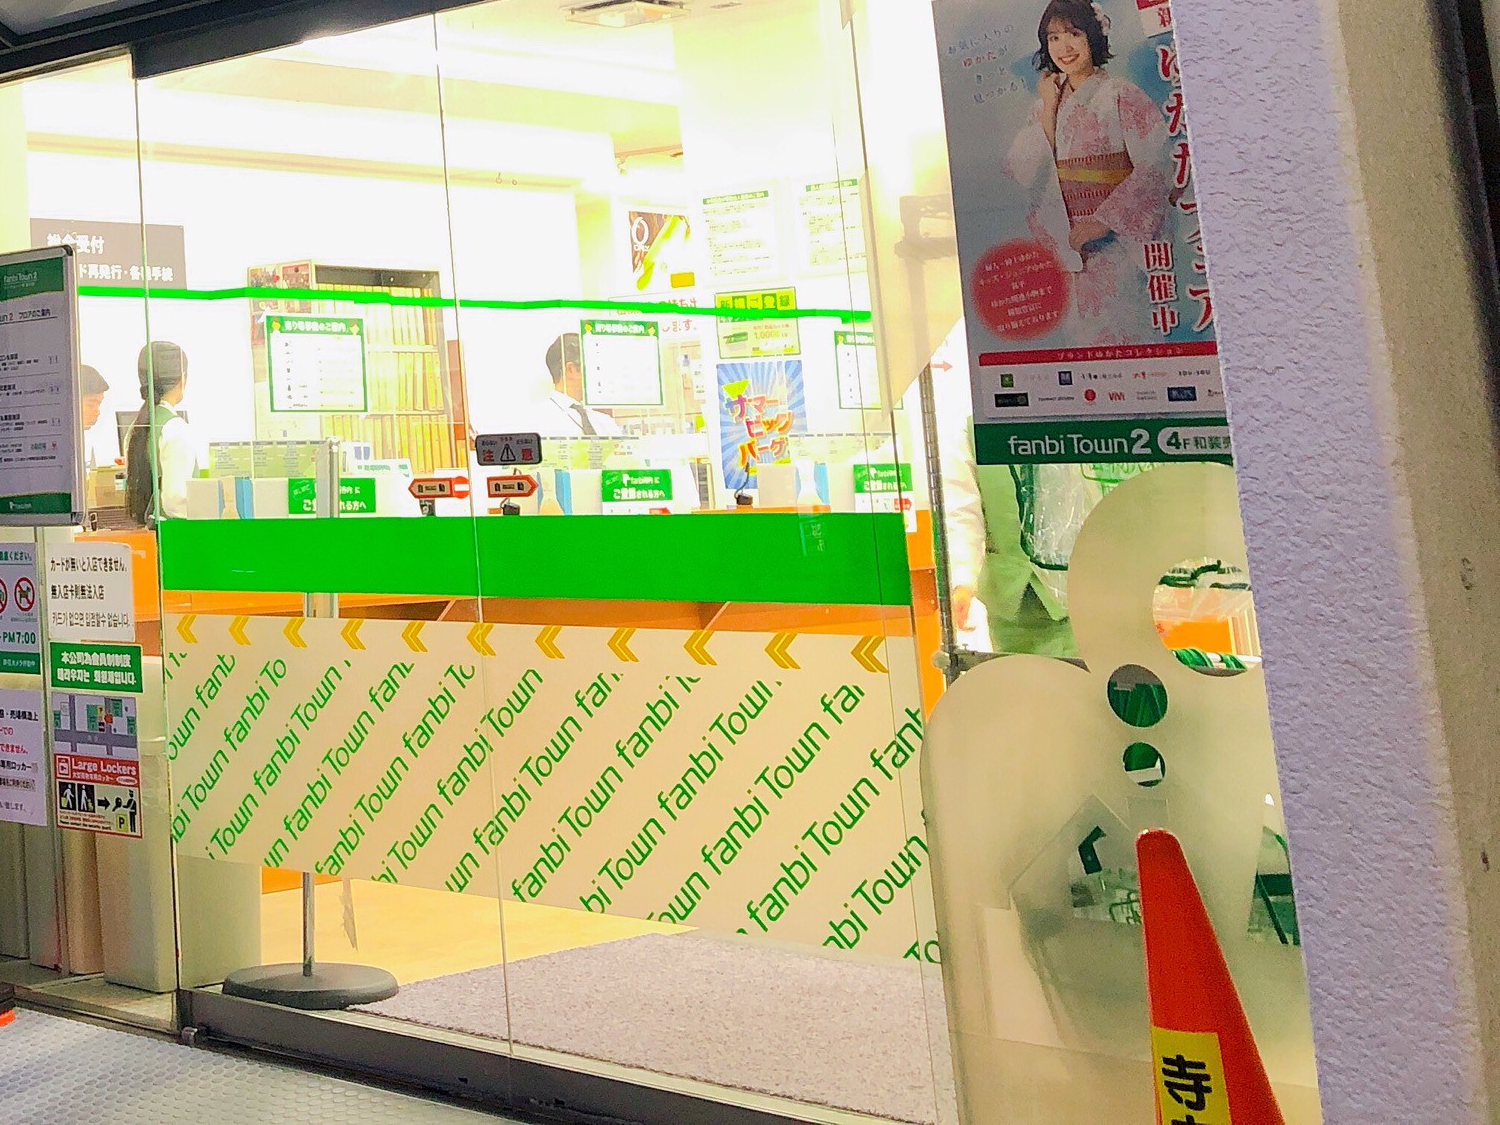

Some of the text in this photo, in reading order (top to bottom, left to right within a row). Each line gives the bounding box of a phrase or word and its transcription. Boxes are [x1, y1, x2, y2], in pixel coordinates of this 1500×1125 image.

[1143, 243, 1175, 334] 開催中
[1008, 435, 1064, 456] fanbi
[1067, 433, 1129, 455] Town
[1130, 428, 1152, 454] 2
[71, 757, 137, 775] Large Lockers
[182, 750, 230, 811] Town
[223, 680, 270, 751] fanbi
[210, 666, 343, 855] Town fanbi Town
[284, 768, 332, 841] fanbi
[322, 710, 375, 776] Town
[354, 756, 409, 822] Town
[402, 681, 456, 758] fanbi
[387, 803, 444, 870] Town
[437, 727, 494, 806] fanbi
[480, 668, 544, 738] Town
[472, 777, 532, 855] fanbi
[518, 715, 582, 786] Town
[511, 684, 680, 903] fanbi Town fanbi
[598, 817, 666, 890] Town
[657, 735, 724, 821] fanbi
[701, 789, 770, 876] fanbi
[754, 721, 830, 800] Town
[118, 816, 125, 829] P
[746, 844, 818, 933] fanbi
[801, 777, 880, 856] Town
[851, 835, 928, 915] Town
